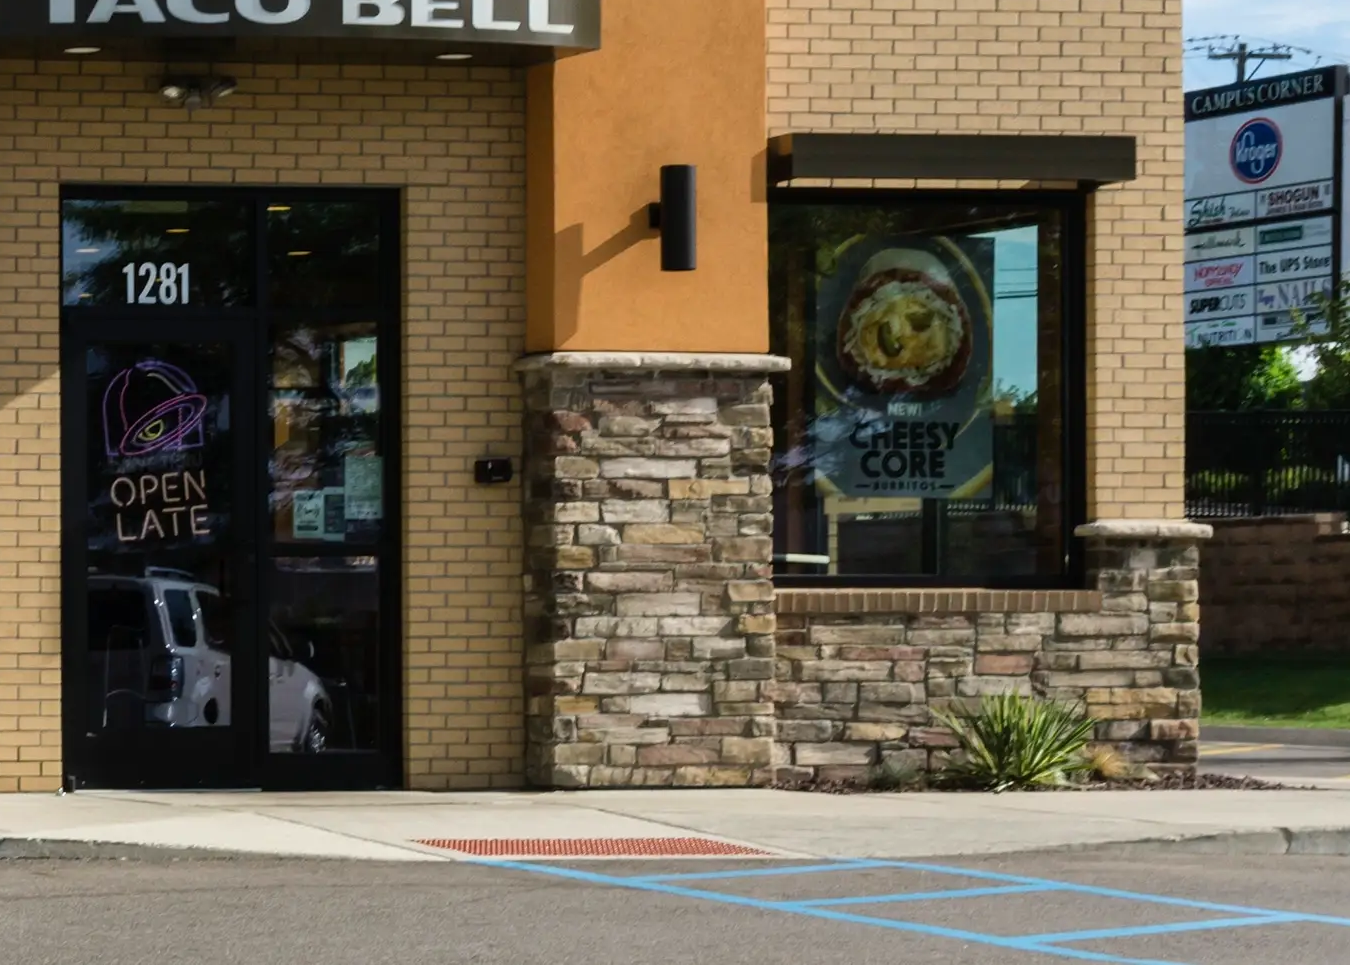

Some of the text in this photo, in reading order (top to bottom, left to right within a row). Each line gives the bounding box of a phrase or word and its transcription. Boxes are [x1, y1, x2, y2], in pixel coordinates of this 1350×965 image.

[1191, 74, 1324, 115] CAMPUS CORNER
[1235, 131, 1277, 174] Kroger
[1259, 260, 1277, 275] The
[1280, 256, 1300, 272] UPS
[1302, 255, 1331, 270] Store
[121, 261, 191, 305] 1281
[887, 402, 922, 417] NEW!
[849, 421, 960, 451] CHEESY
[860, 450, 946, 479] CORE
[110, 469, 206, 508] OPEN
[872, 481, 937, 492] BURRITOS
[116, 504, 210, 542] LATE
